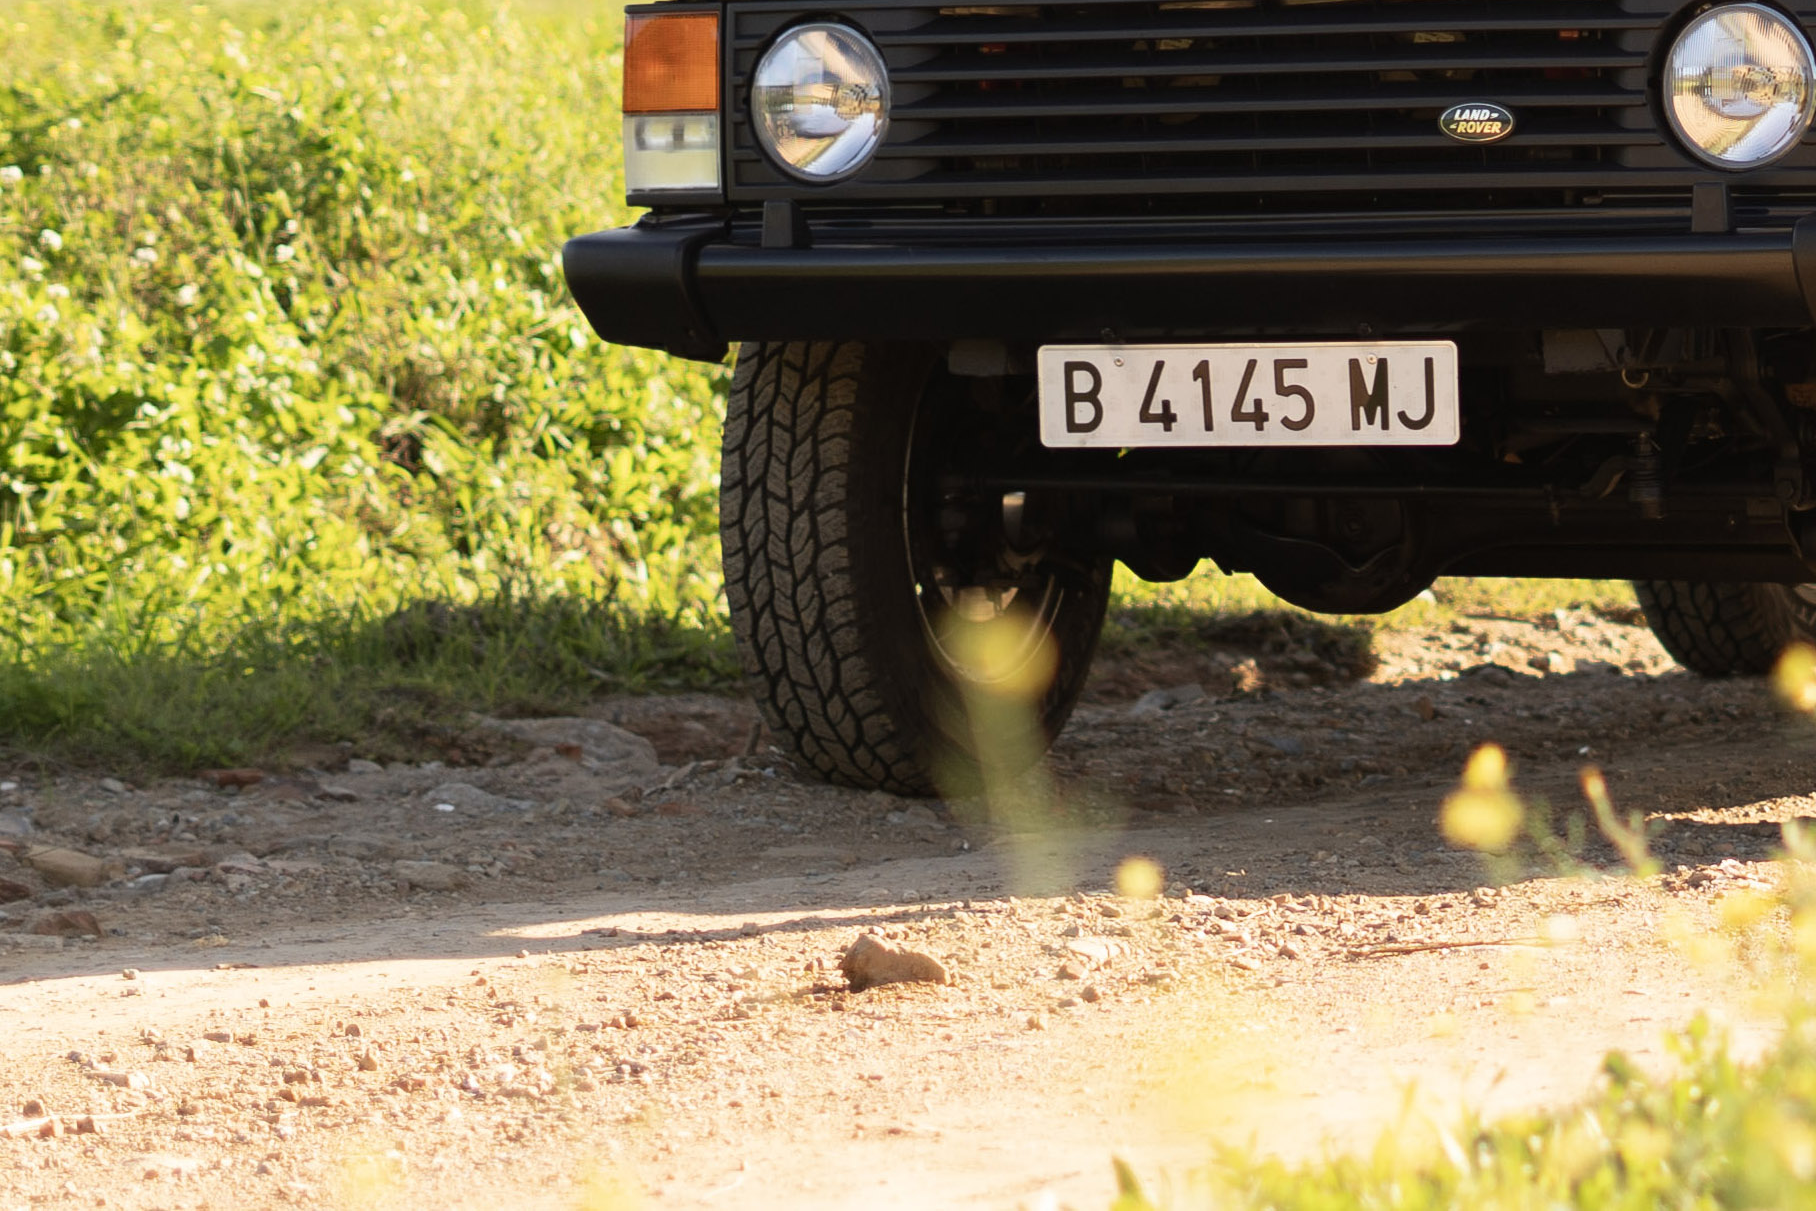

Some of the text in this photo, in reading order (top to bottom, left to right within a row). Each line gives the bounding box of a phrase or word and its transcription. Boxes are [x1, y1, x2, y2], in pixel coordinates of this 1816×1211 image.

[1454, 109, 1491, 121] LAND
[1456, 121, 1502, 134] ROVER
[1063, 356, 1436, 434] B 4145 MJ
